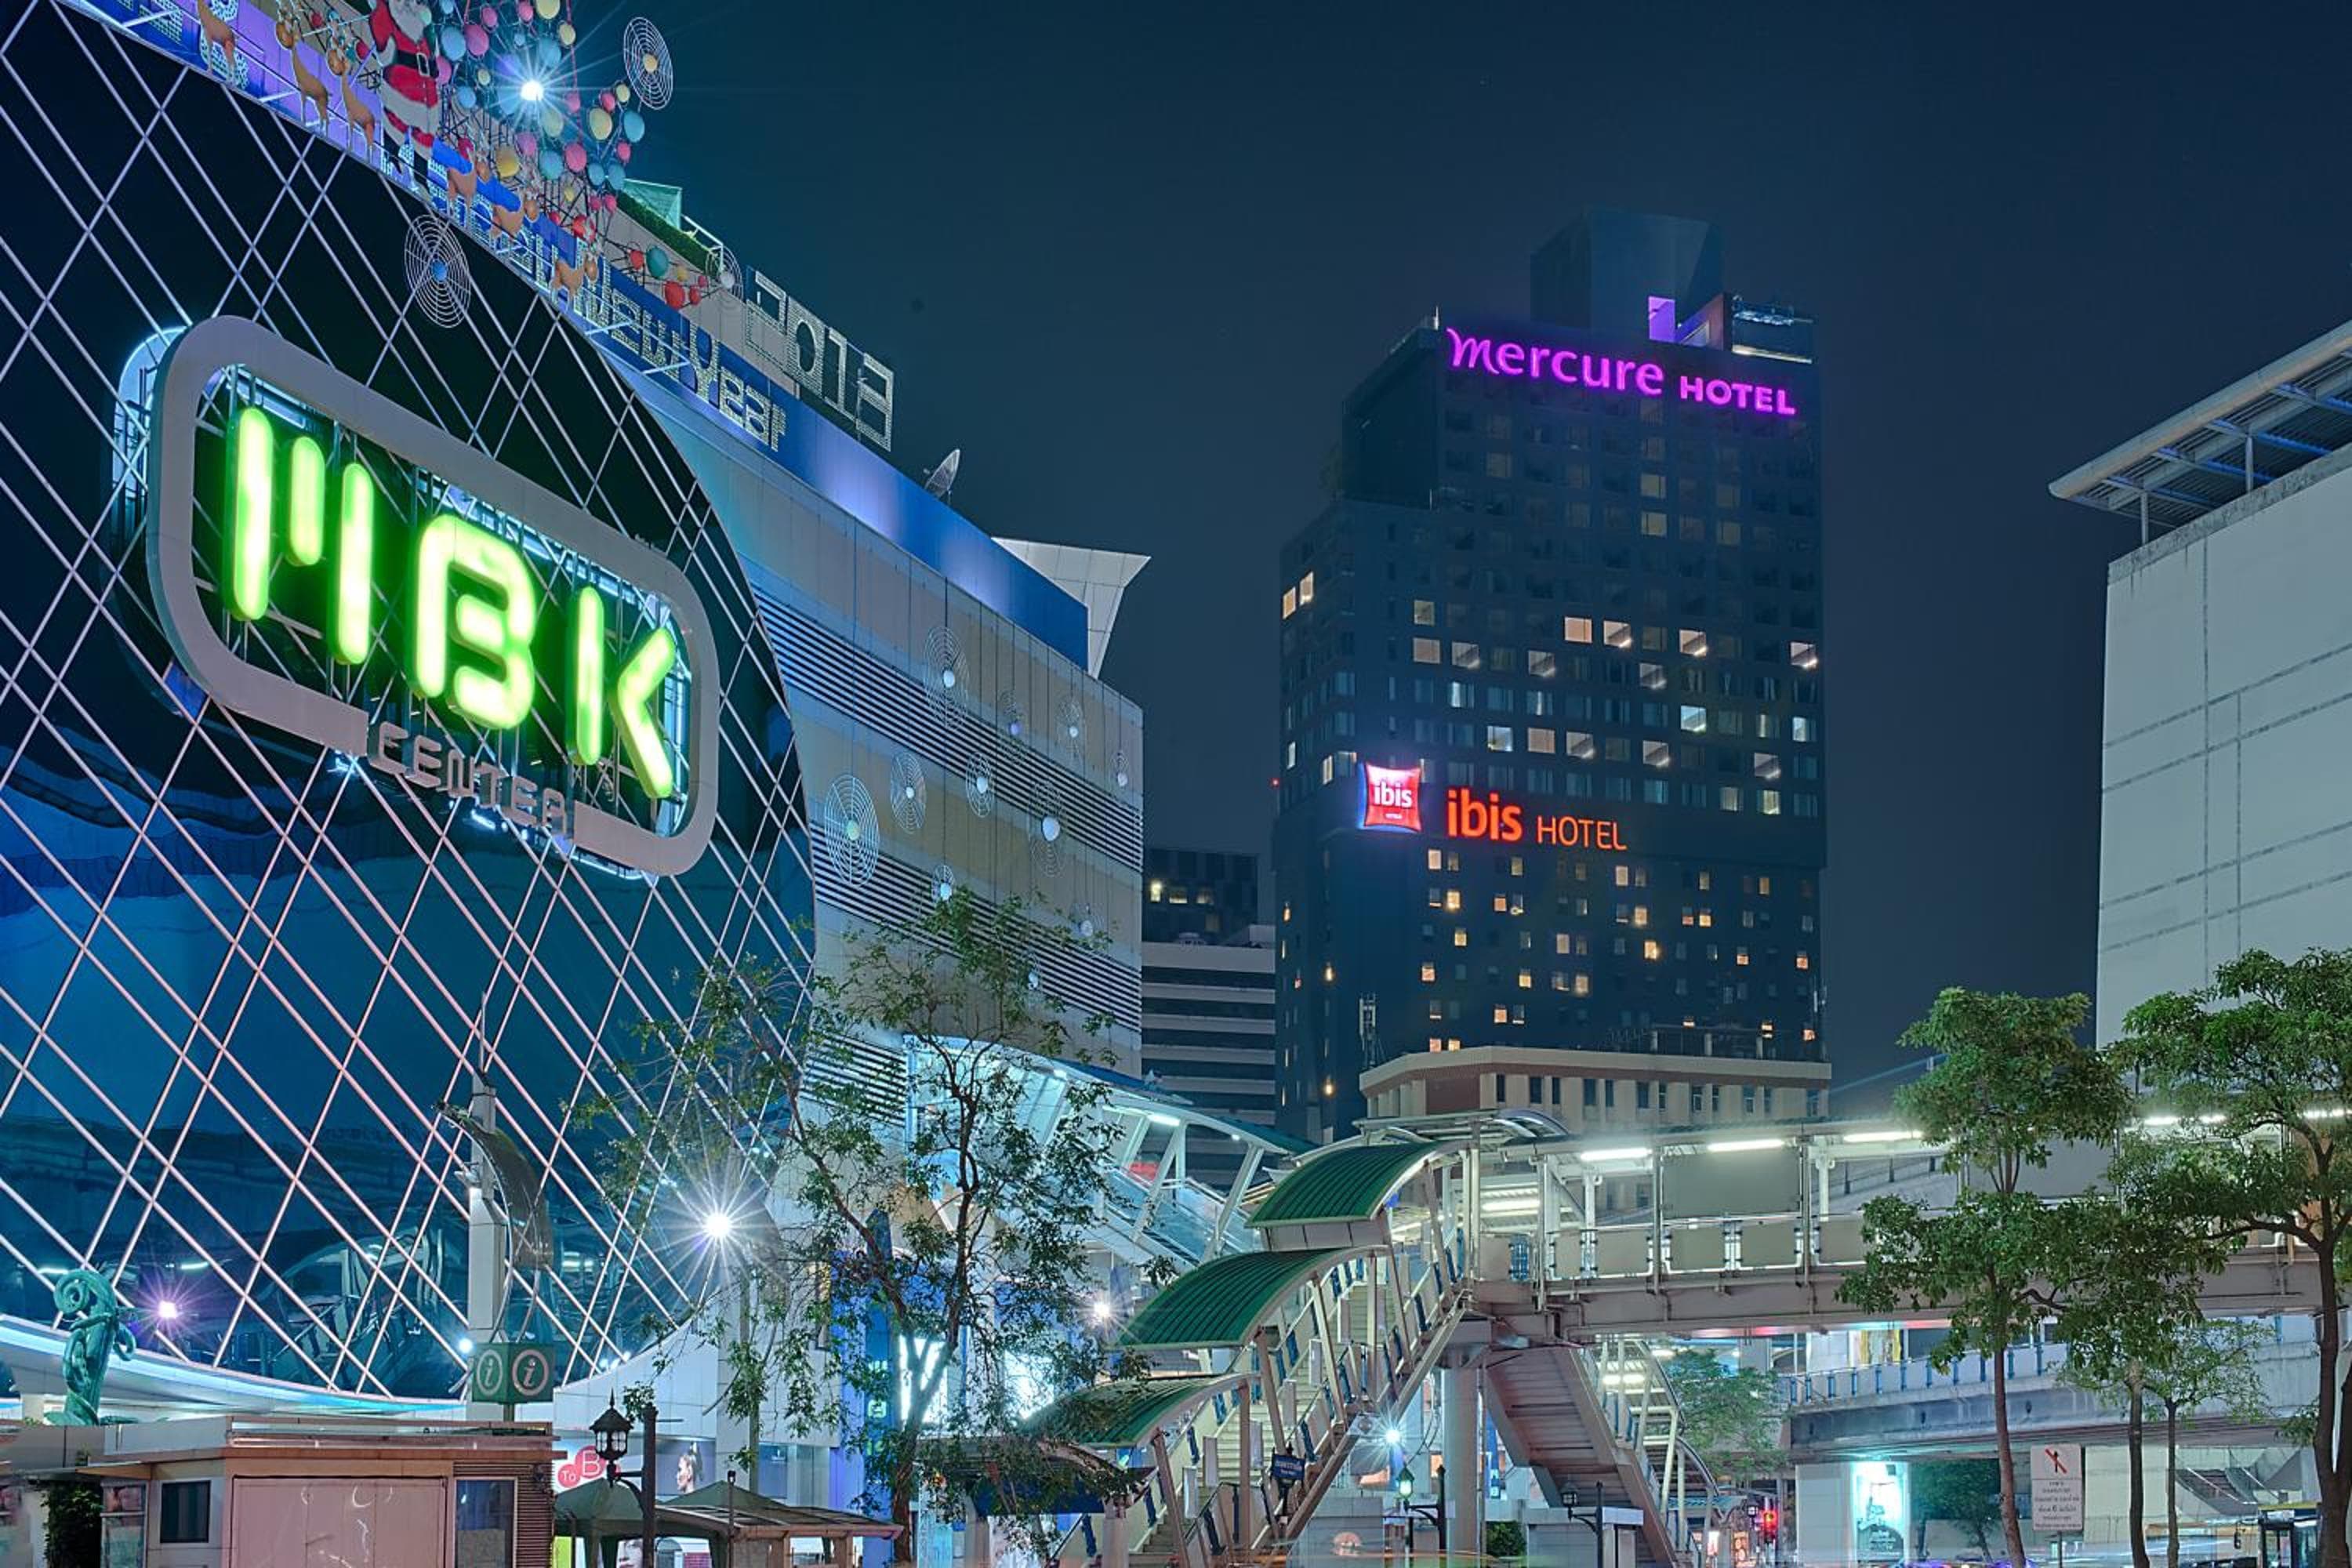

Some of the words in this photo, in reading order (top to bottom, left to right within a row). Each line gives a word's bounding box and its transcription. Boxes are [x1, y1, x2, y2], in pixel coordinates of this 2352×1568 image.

[689, 320, 786, 452] Year
[1679, 375, 1798, 416] HOTEL
[224, 406, 676, 800] MBK
[1374, 780, 1413, 808] ibis
[1447, 788, 1523, 842] ibis
[1537, 815, 1628, 851] HOTEL
[561, 1469, 576, 1482] To
